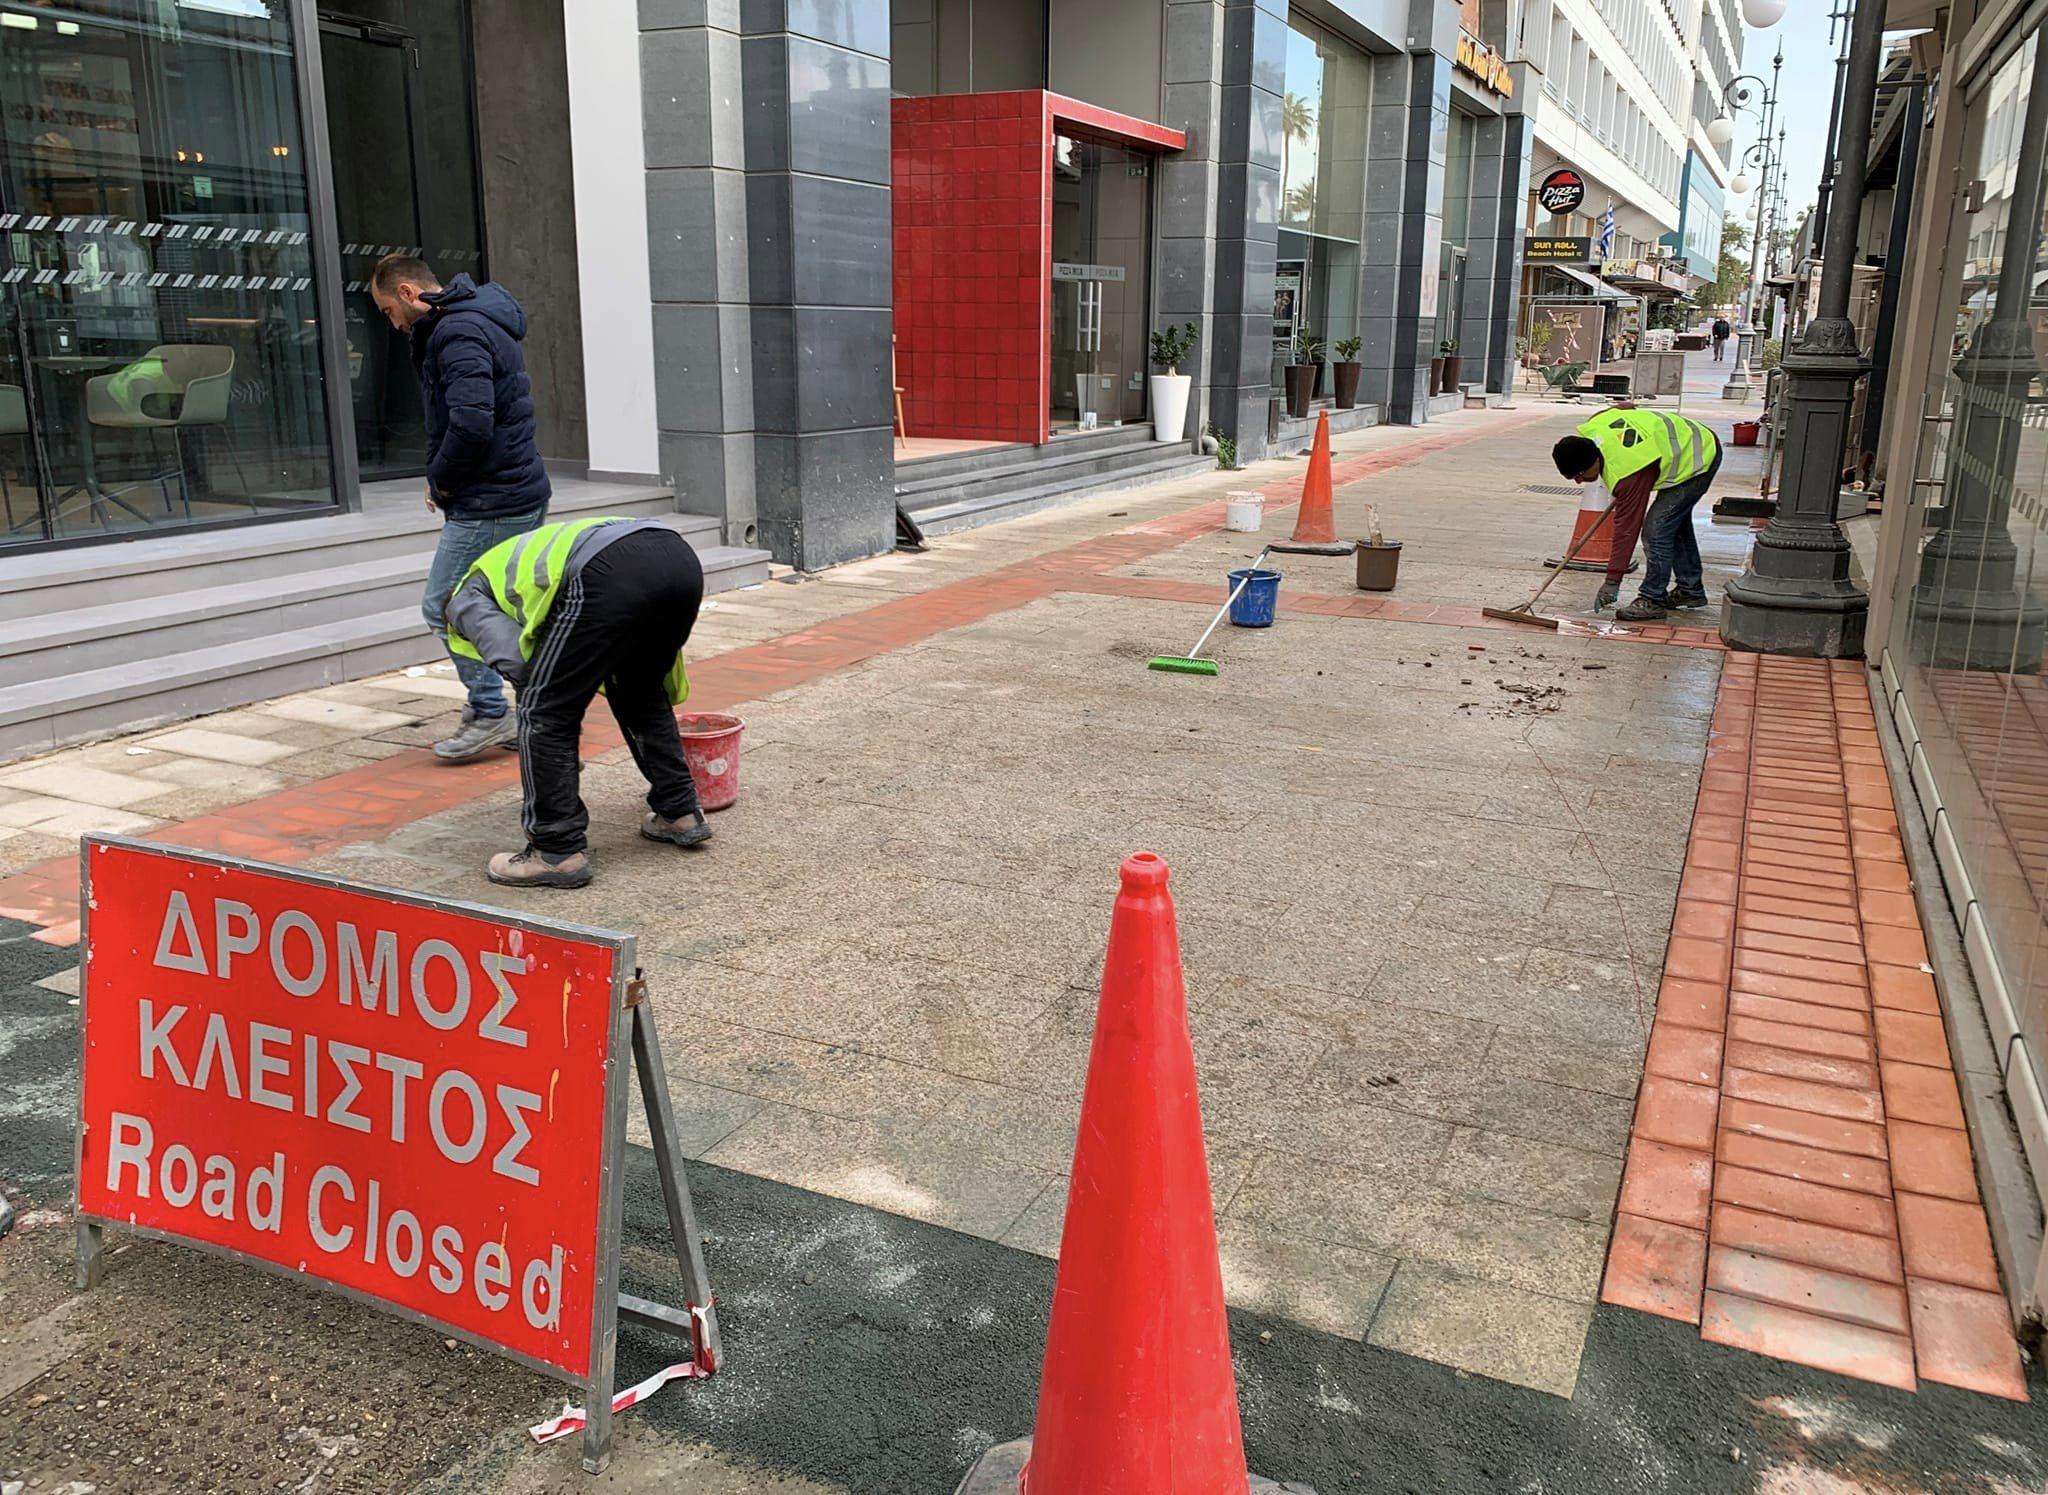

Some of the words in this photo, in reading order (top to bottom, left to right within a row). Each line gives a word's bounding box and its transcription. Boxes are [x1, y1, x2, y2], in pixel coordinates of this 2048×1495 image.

[1548, 195, 1575, 206] Hut
[152, 889, 529, 1048] ΔΡΟΜΟΣ
[137, 998, 543, 1187] ΚΛΕΙΣΤΟΣ
[105, 1111, 286, 1235] Road
[306, 1164, 566, 1334] Closed
